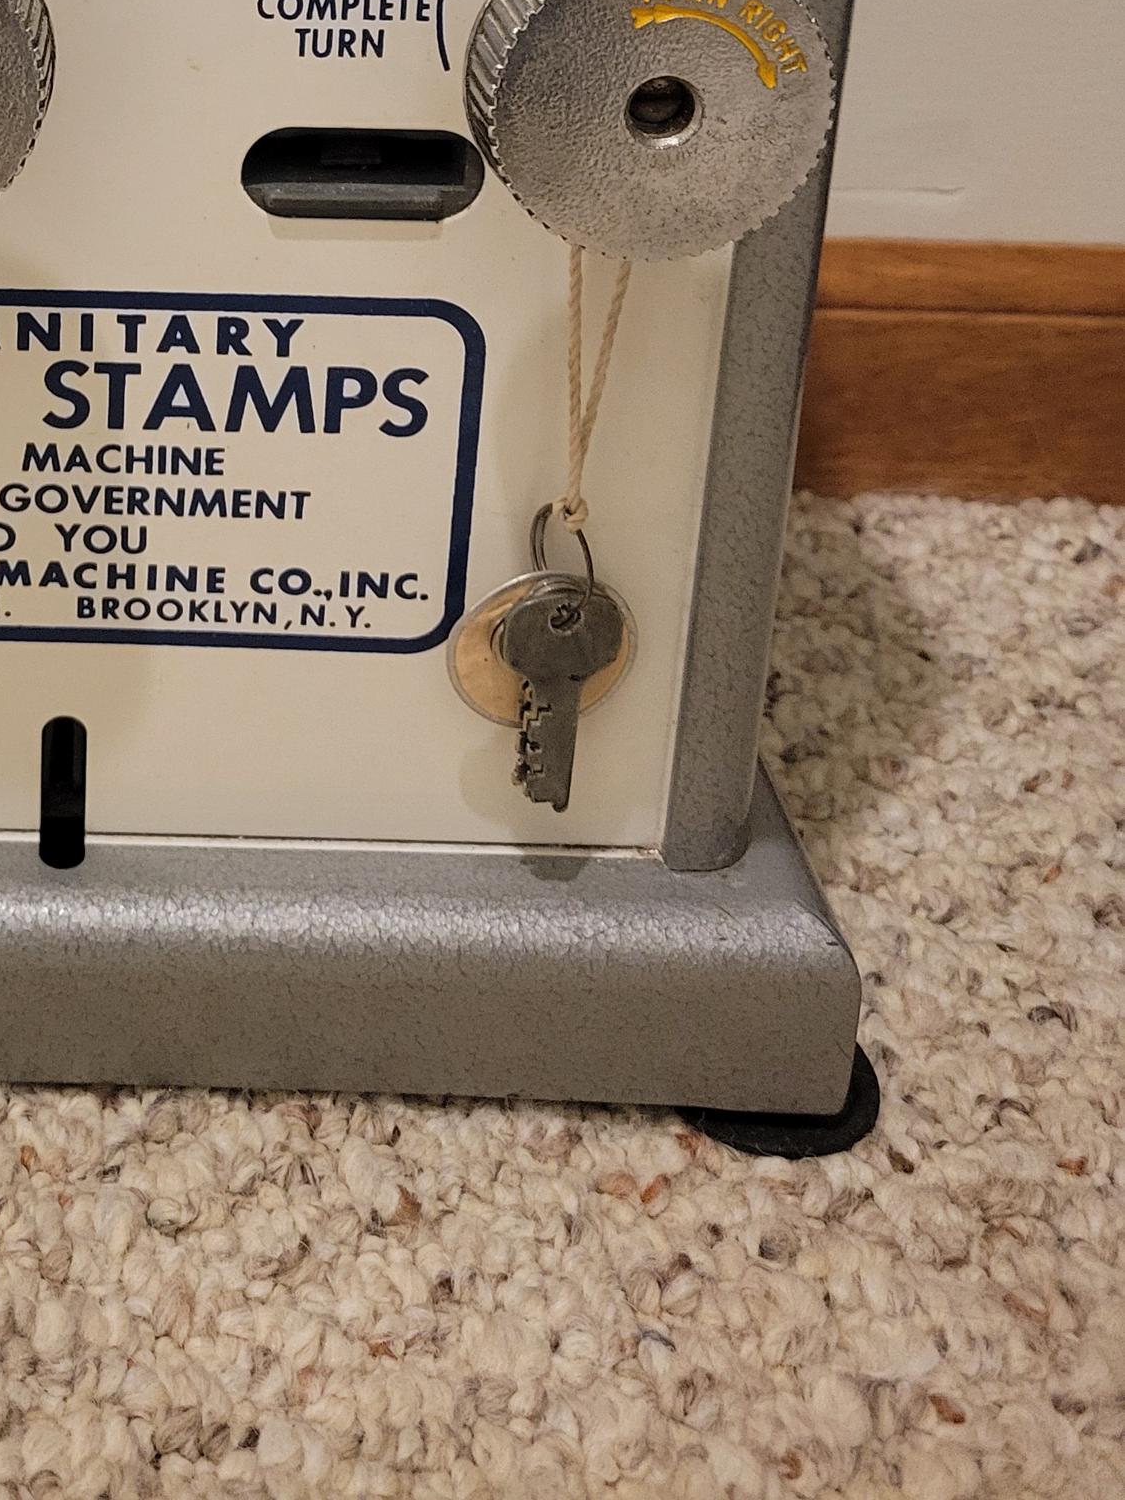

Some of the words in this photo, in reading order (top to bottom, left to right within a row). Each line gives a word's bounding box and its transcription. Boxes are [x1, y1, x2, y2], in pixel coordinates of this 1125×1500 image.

[295, 28, 385, 58] TURN
[42, 359, 429, 437] STAMPS
[22, 442, 225, 476] MACHINE
[0, 483, 311, 520] GOVERNMENT
[54, 523, 147, 554] YOU
